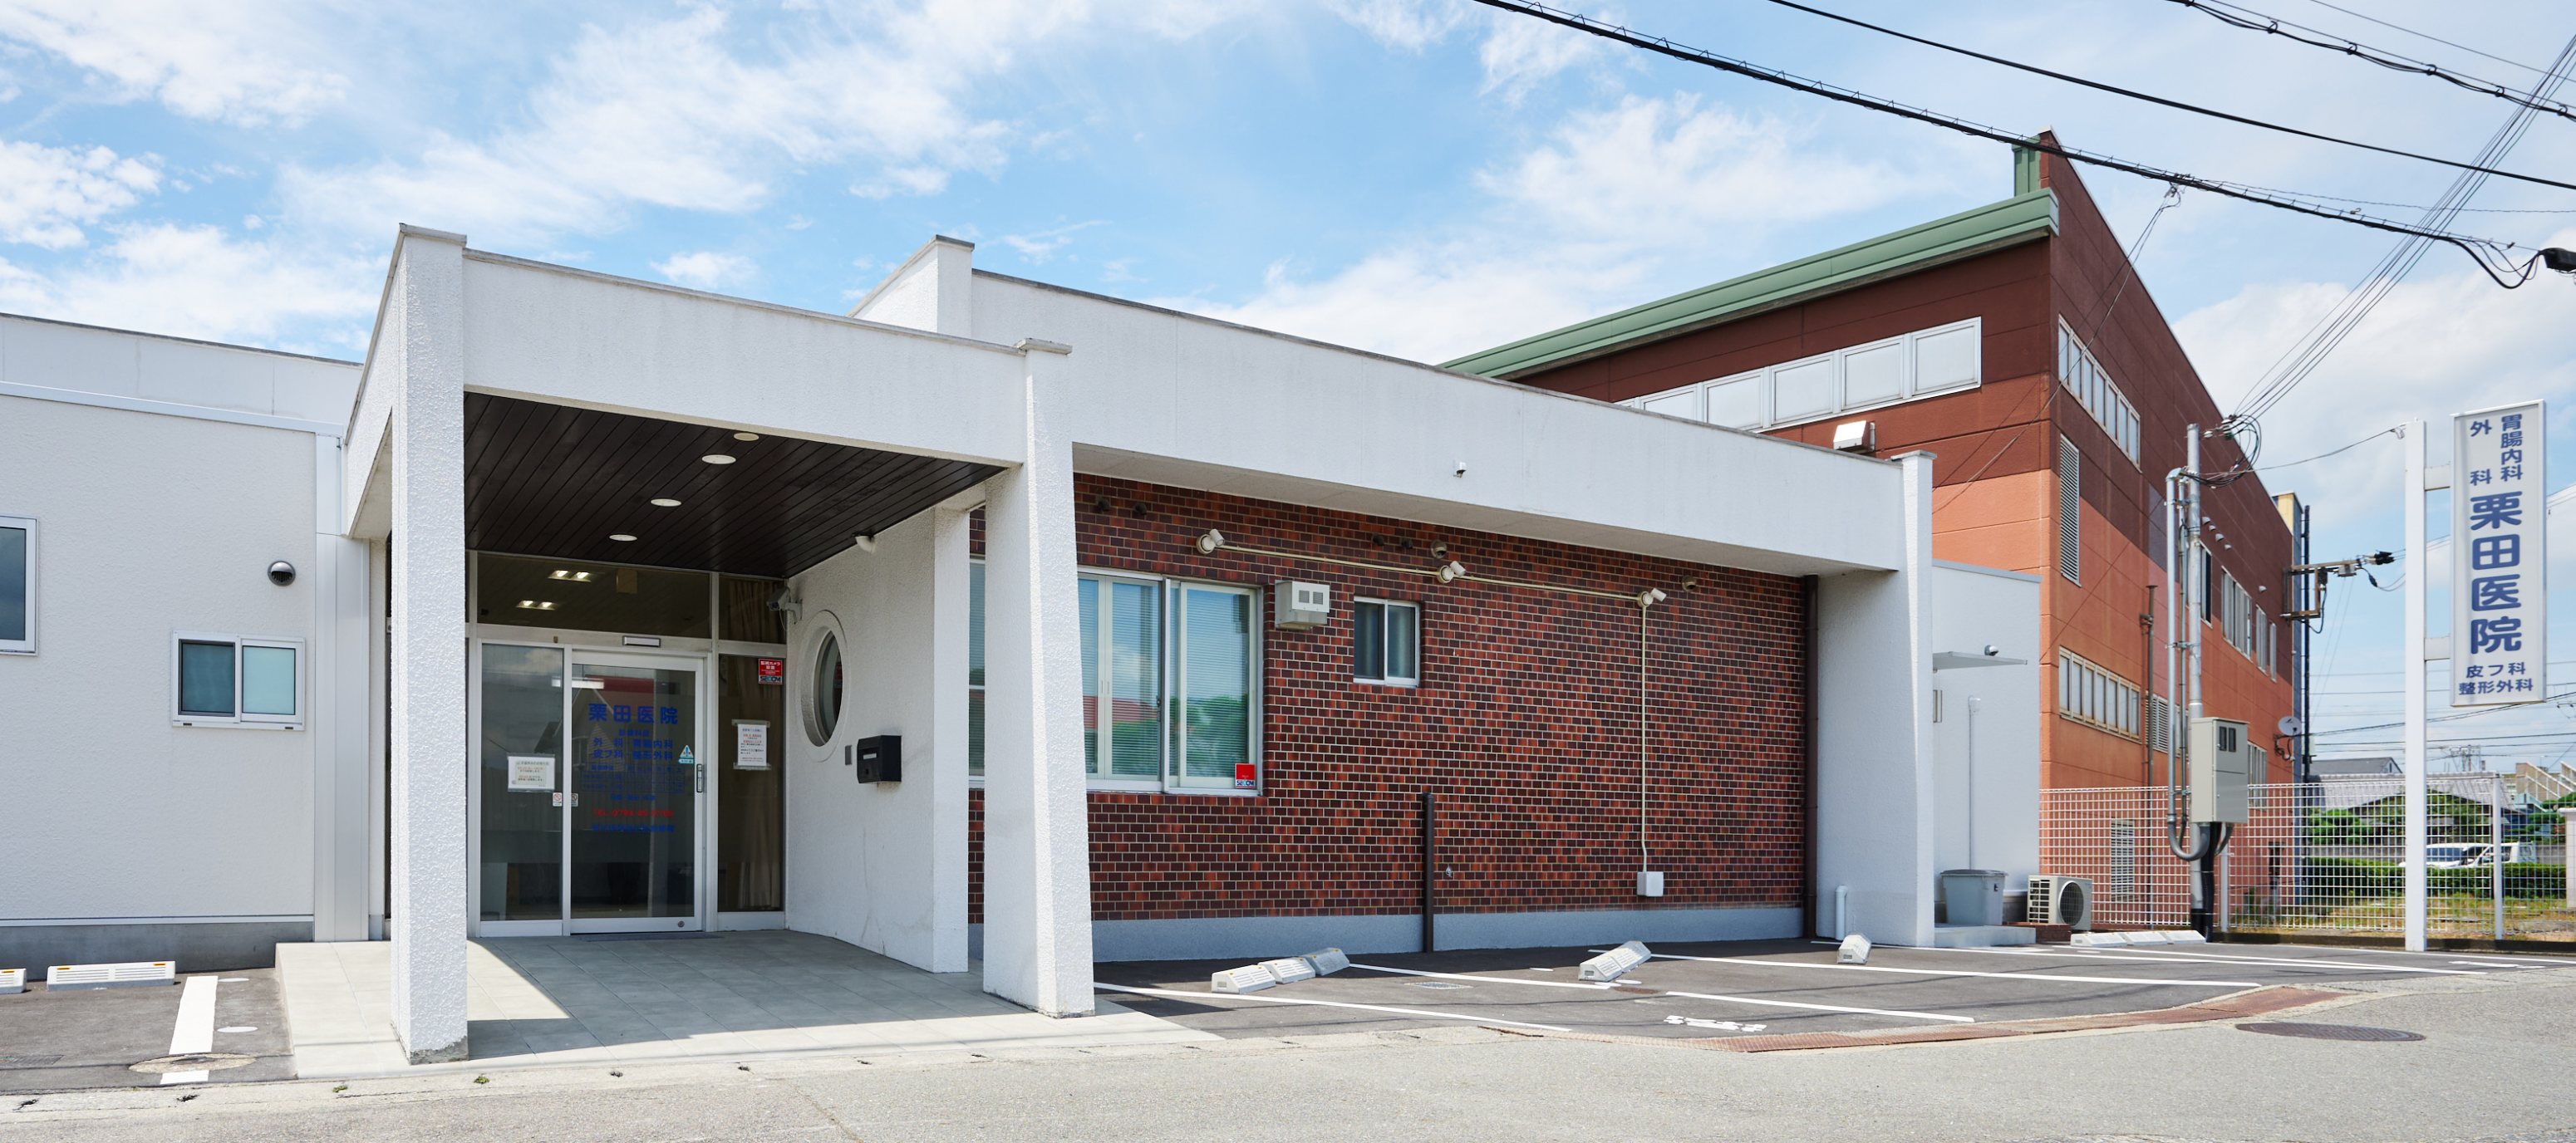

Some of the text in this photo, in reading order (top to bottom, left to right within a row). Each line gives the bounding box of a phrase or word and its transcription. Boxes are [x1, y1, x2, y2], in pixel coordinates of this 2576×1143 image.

[2500, 414, 2523, 482] 胃腸内科
[2470, 491, 2523, 655] 栗田医院
[2465, 662, 2526, 679] 皮フ科
[2458, 679, 2534, 695] 整形外科
[588, 703, 678, 725] 栗田医院
